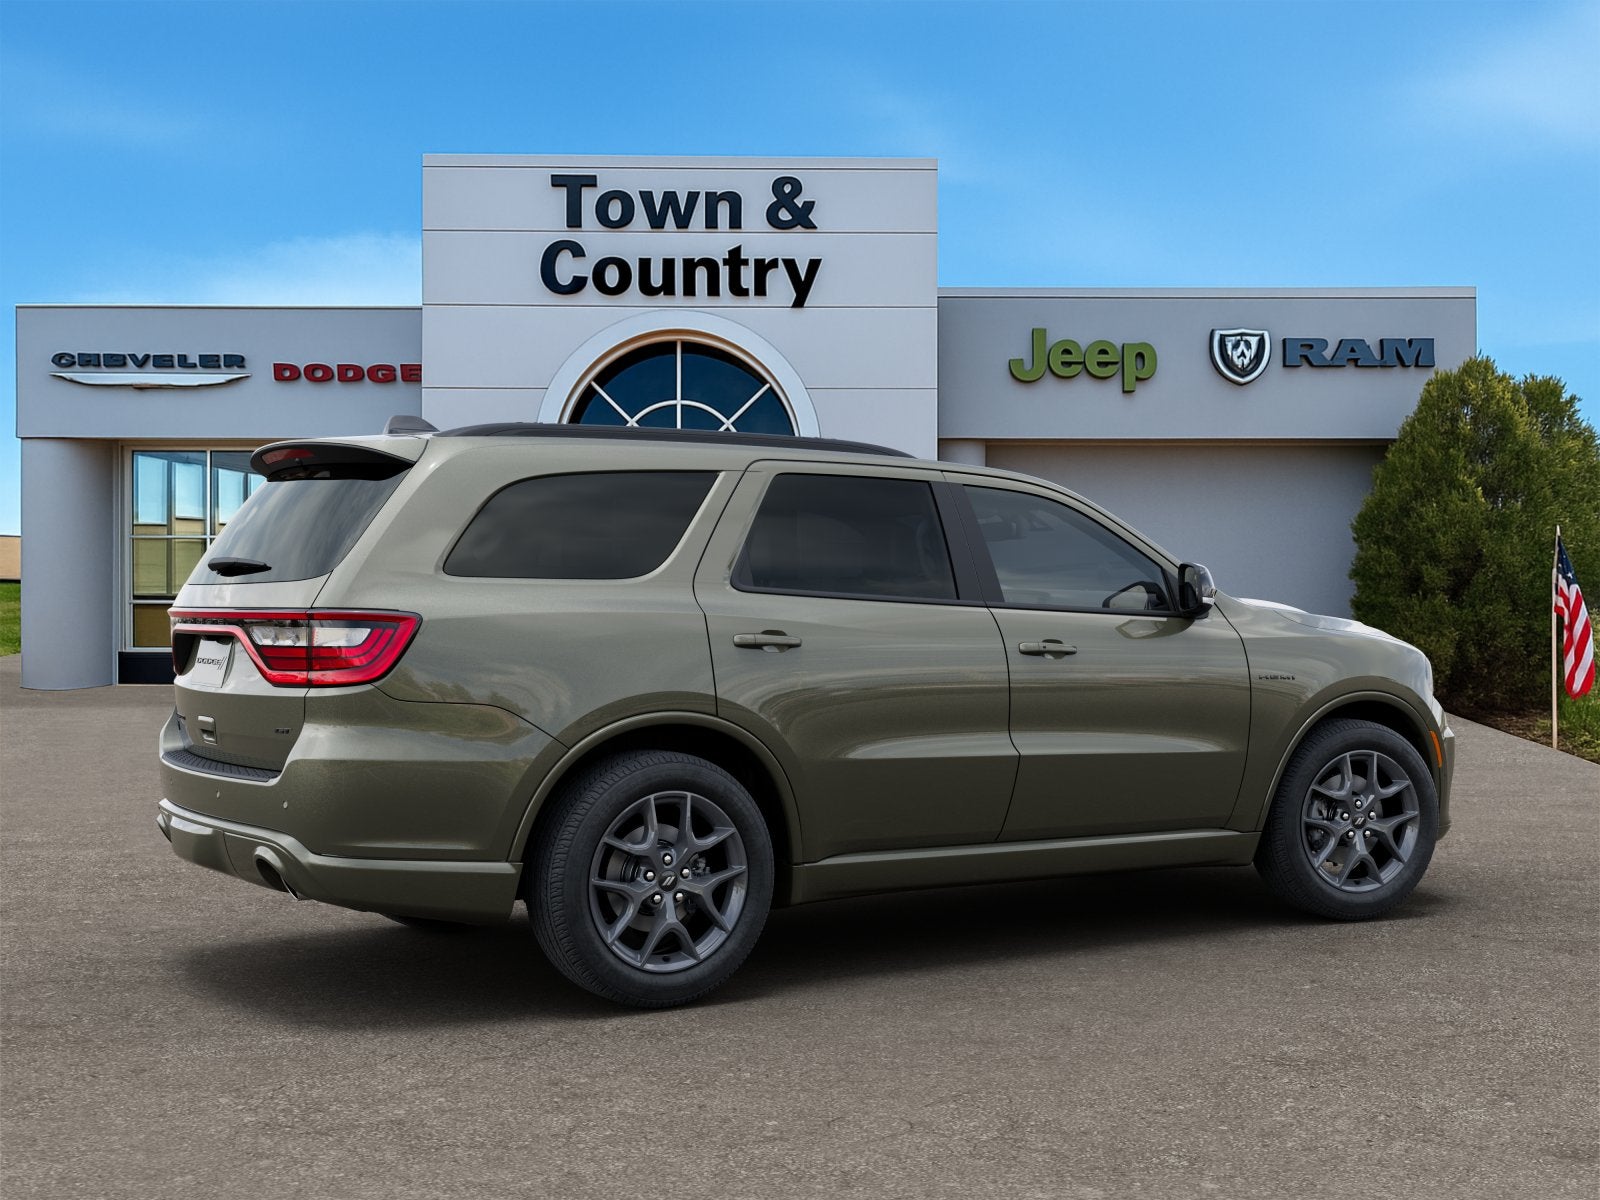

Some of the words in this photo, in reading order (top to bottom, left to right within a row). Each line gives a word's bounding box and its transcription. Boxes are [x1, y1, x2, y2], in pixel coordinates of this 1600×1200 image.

[550, 174, 742, 230] Town
[765, 175, 818, 230] &
[540, 239, 823, 308] Country
[273, 362, 422, 383] DODGE
[1009, 328, 1158, 393] Jeep
[1282, 337, 1436, 368] RAM
